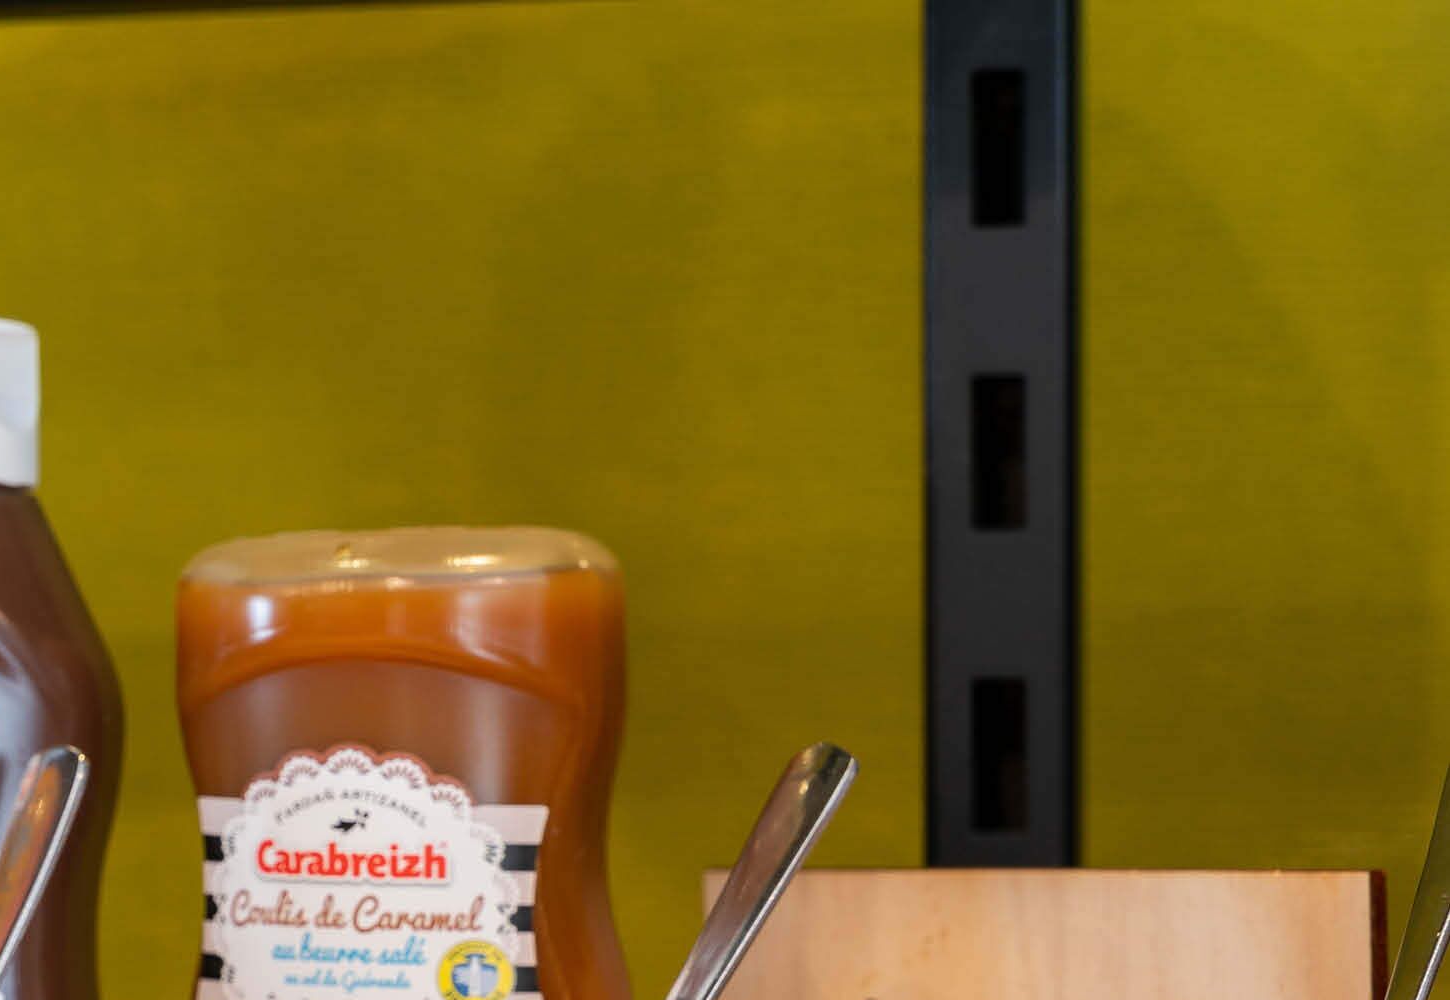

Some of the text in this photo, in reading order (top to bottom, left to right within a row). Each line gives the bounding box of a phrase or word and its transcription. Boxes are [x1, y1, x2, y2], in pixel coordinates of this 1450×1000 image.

[256, 838, 448, 880] Carabreizh
[229, 888, 485, 933] Coulis de Caramel
[271, 943, 296, 961] au
[299, 931, 374, 964] beurre
[377, 934, 428, 966] salé
